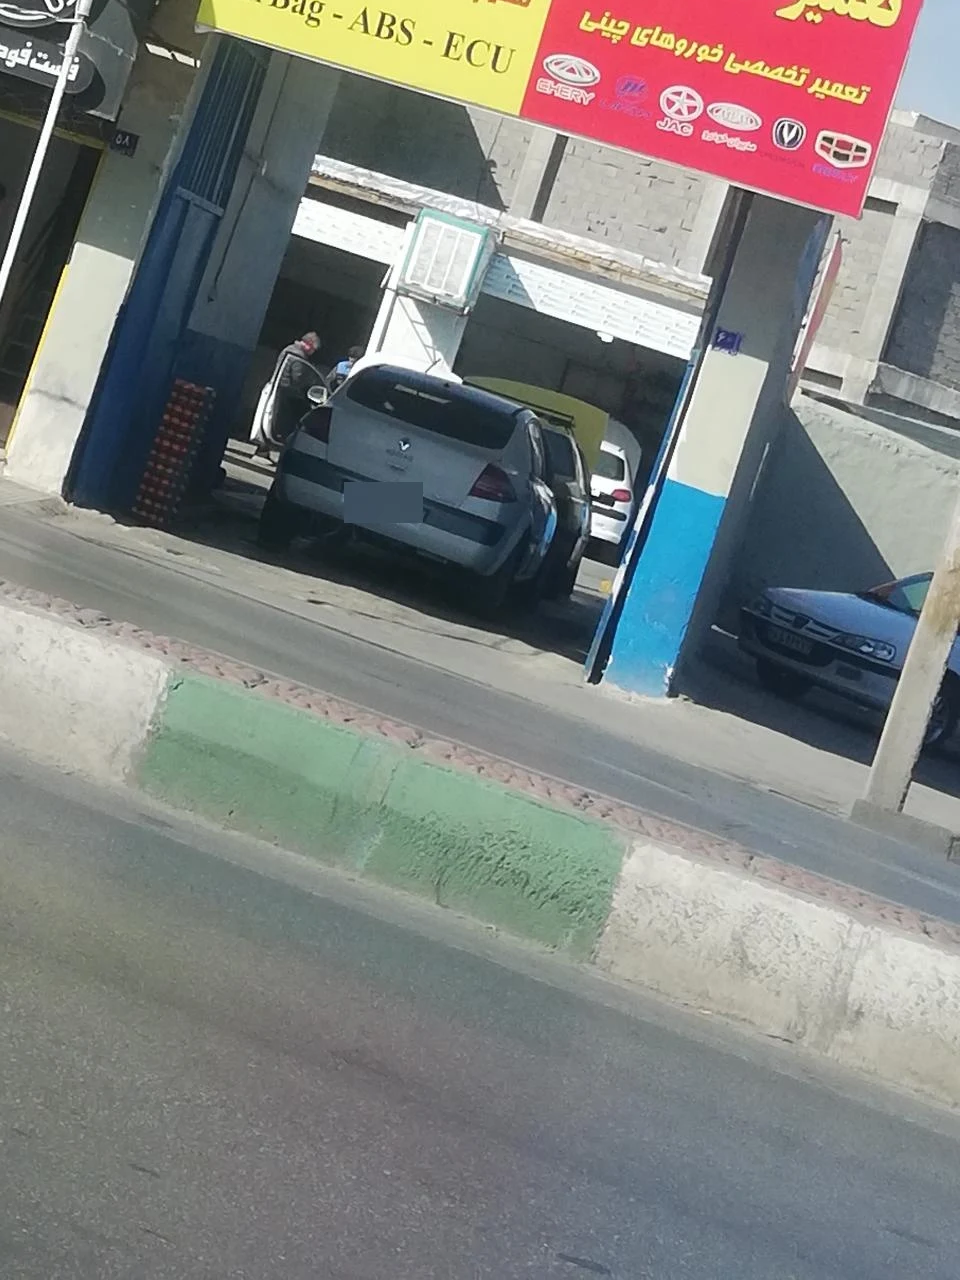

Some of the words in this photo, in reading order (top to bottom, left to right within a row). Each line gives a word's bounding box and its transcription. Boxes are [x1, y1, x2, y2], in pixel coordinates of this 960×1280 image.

[346, 6, 417, 47] ABS
[440, 30, 517, 75] ECU
[579, 11, 632, 45] چینی
[723, 52, 811, 88] تخصصی
[807, 76, 872, 105] تعمیر
[656, 118, 694, 136] JAC
